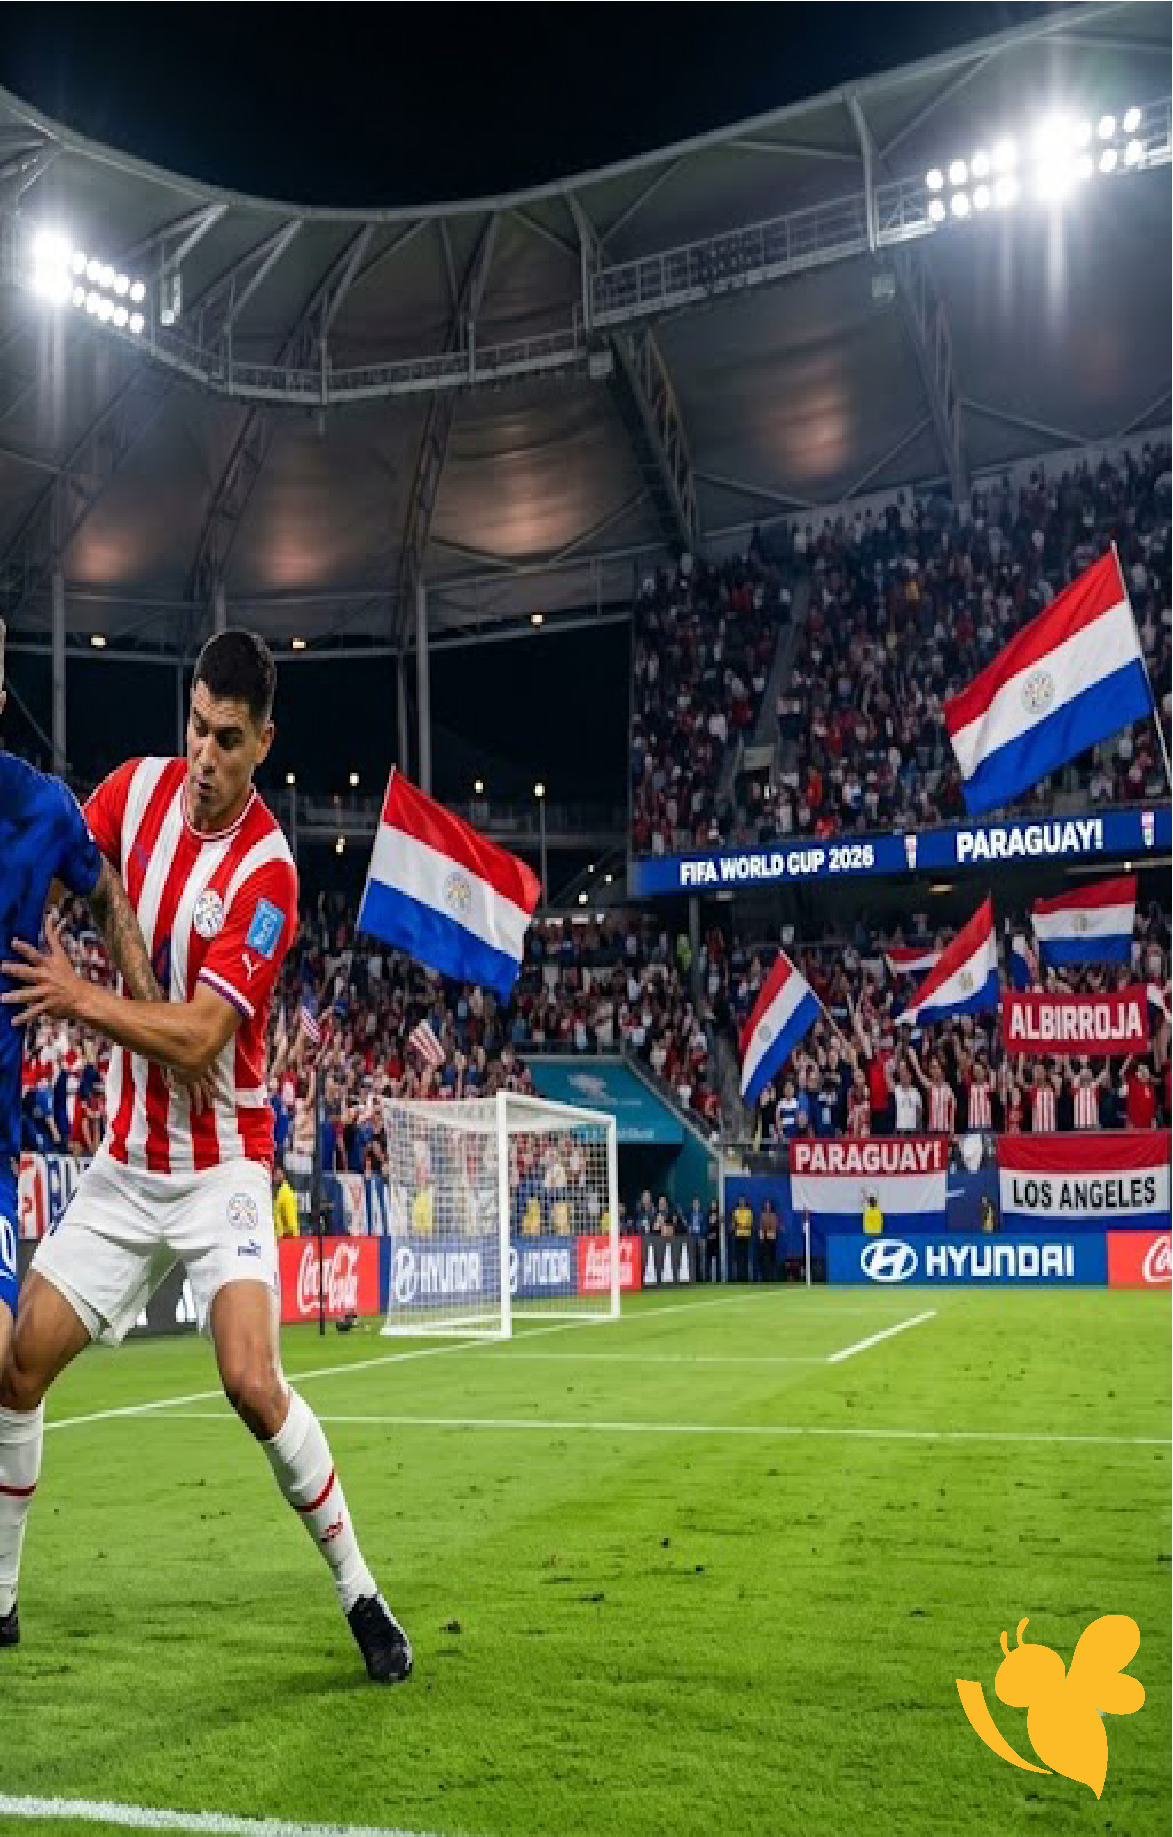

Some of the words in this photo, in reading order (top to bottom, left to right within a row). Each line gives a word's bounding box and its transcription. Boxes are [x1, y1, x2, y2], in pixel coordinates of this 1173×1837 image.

[956, 819, 1104, 863] PARAGUAY!
[680, 858, 720, 886] FIFA
[720, 852, 785, 882] WORLD
[786, 848, 825, 876] CUP
[1008, 1002, 1144, 1040] ALBIRROJA
[794, 1140, 943, 1173] PARAGUAY!
[1012, 1178, 1053, 1209] LOS
[1058, 1176, 1157, 1211] ANGELES
[925, 1244, 1076, 1278] HYUNDAI
